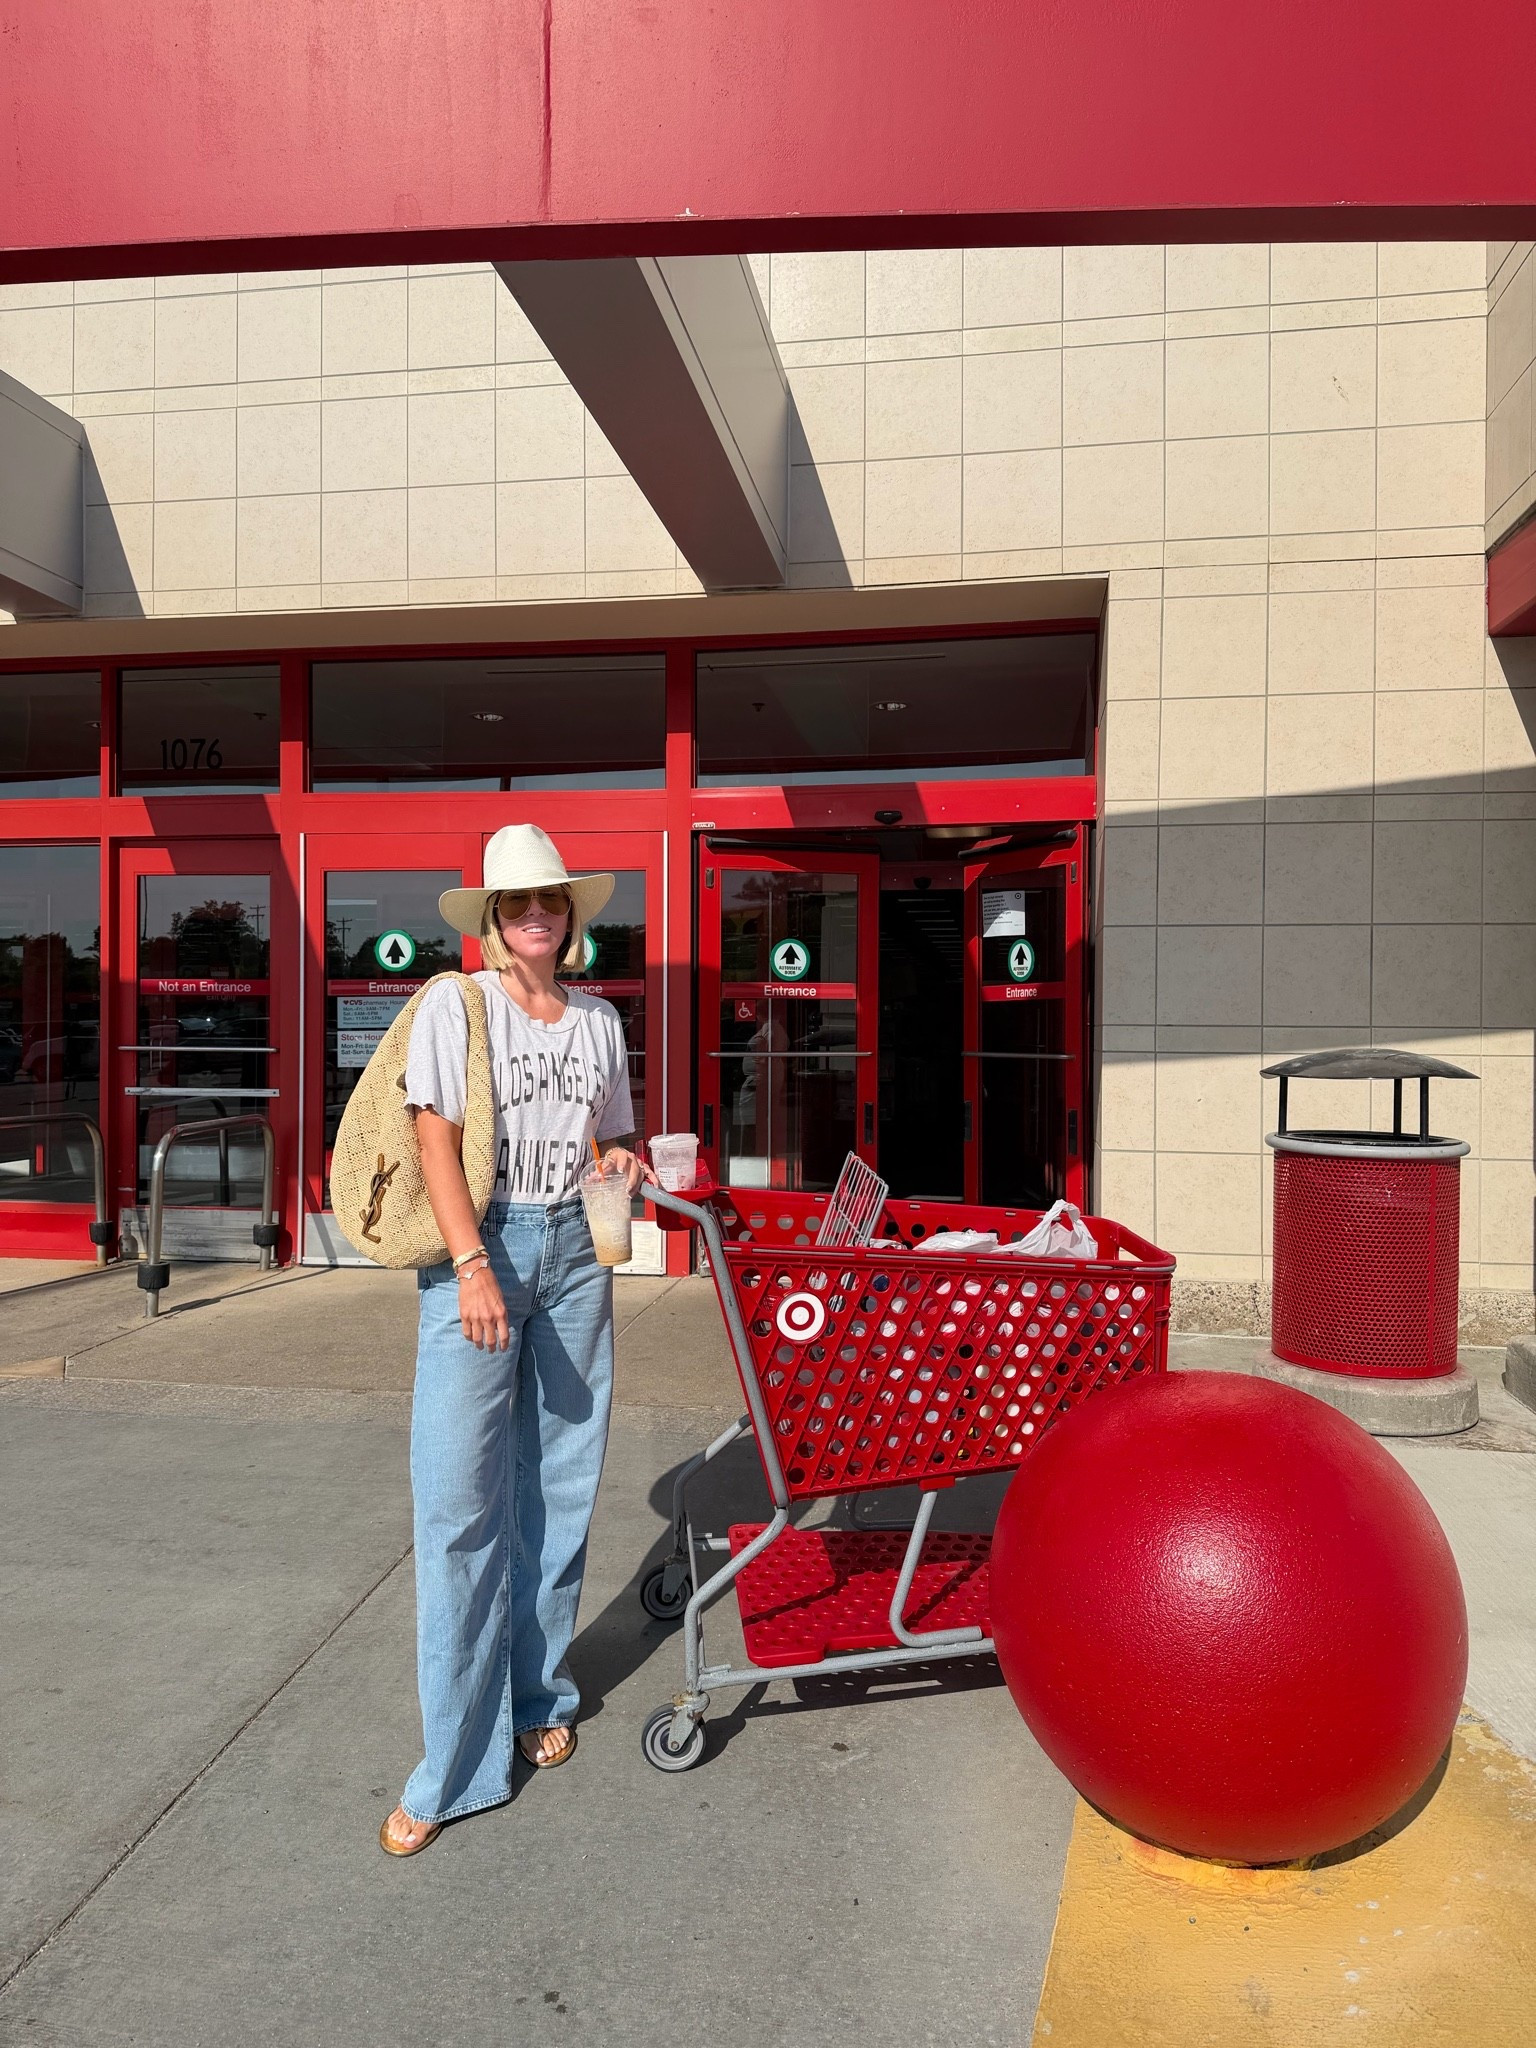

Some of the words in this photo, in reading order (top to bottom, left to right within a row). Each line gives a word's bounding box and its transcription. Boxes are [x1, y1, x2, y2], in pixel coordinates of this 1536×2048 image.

[161, 738, 223, 770] 1076
[158, 981, 179, 992] Not
[182, 984, 196, 992] an
[199, 981, 252, 992] Entrance
[368, 982, 421, 993] Entrance
[764, 985, 817, 997] Entrance
[1006, 987, 1038, 998] Entrance
[499, 1053, 534, 1113] LOS
[494, 1138, 560, 1194] ANINE
